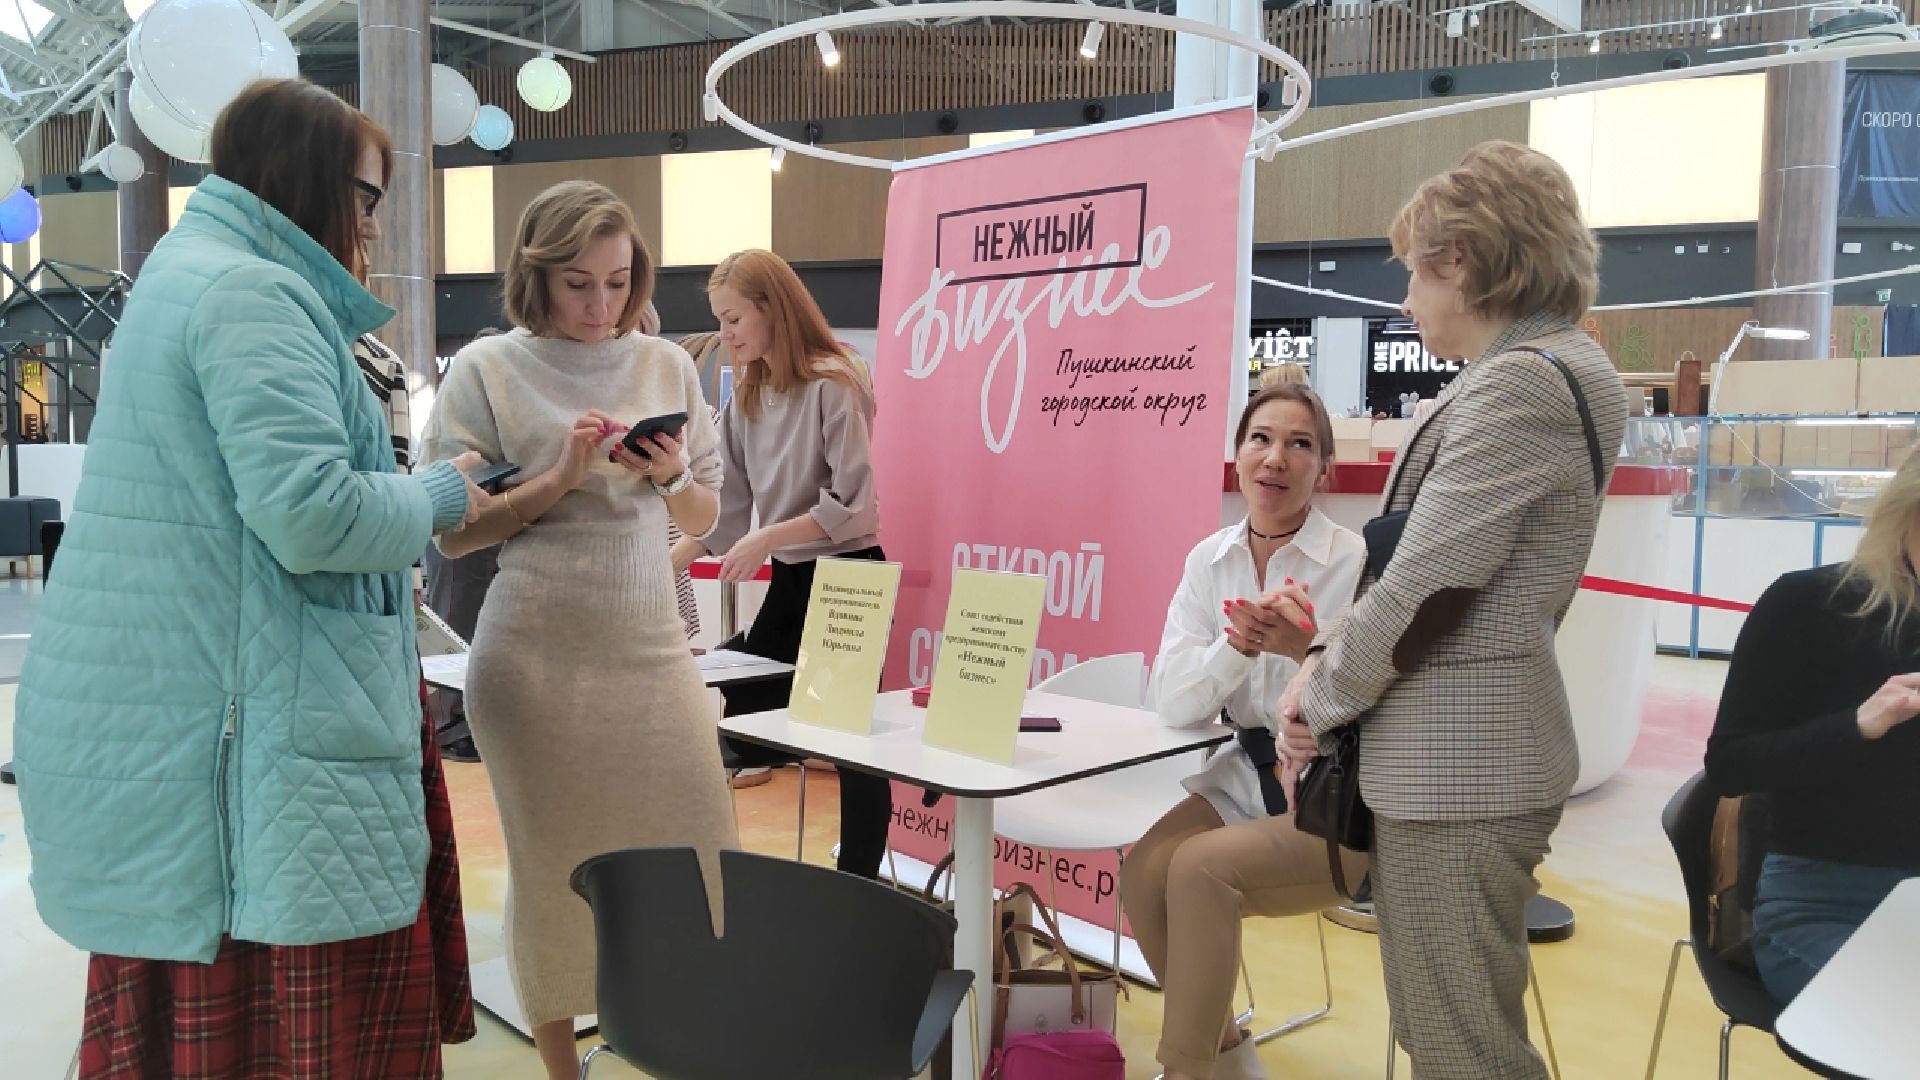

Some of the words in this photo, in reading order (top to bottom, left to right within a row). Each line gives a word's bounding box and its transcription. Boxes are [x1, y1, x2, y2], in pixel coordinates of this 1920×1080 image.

[1862, 111, 1912, 128] СКОРО
[973, 202, 1095, 262] НЕЖНЫЙ
[1056, 345, 1198, 389] Пушкинский
[1374, 341, 1388, 372] ONE
[1041, 386, 1138, 427] городской
[1143, 393, 1208, 427] округ
